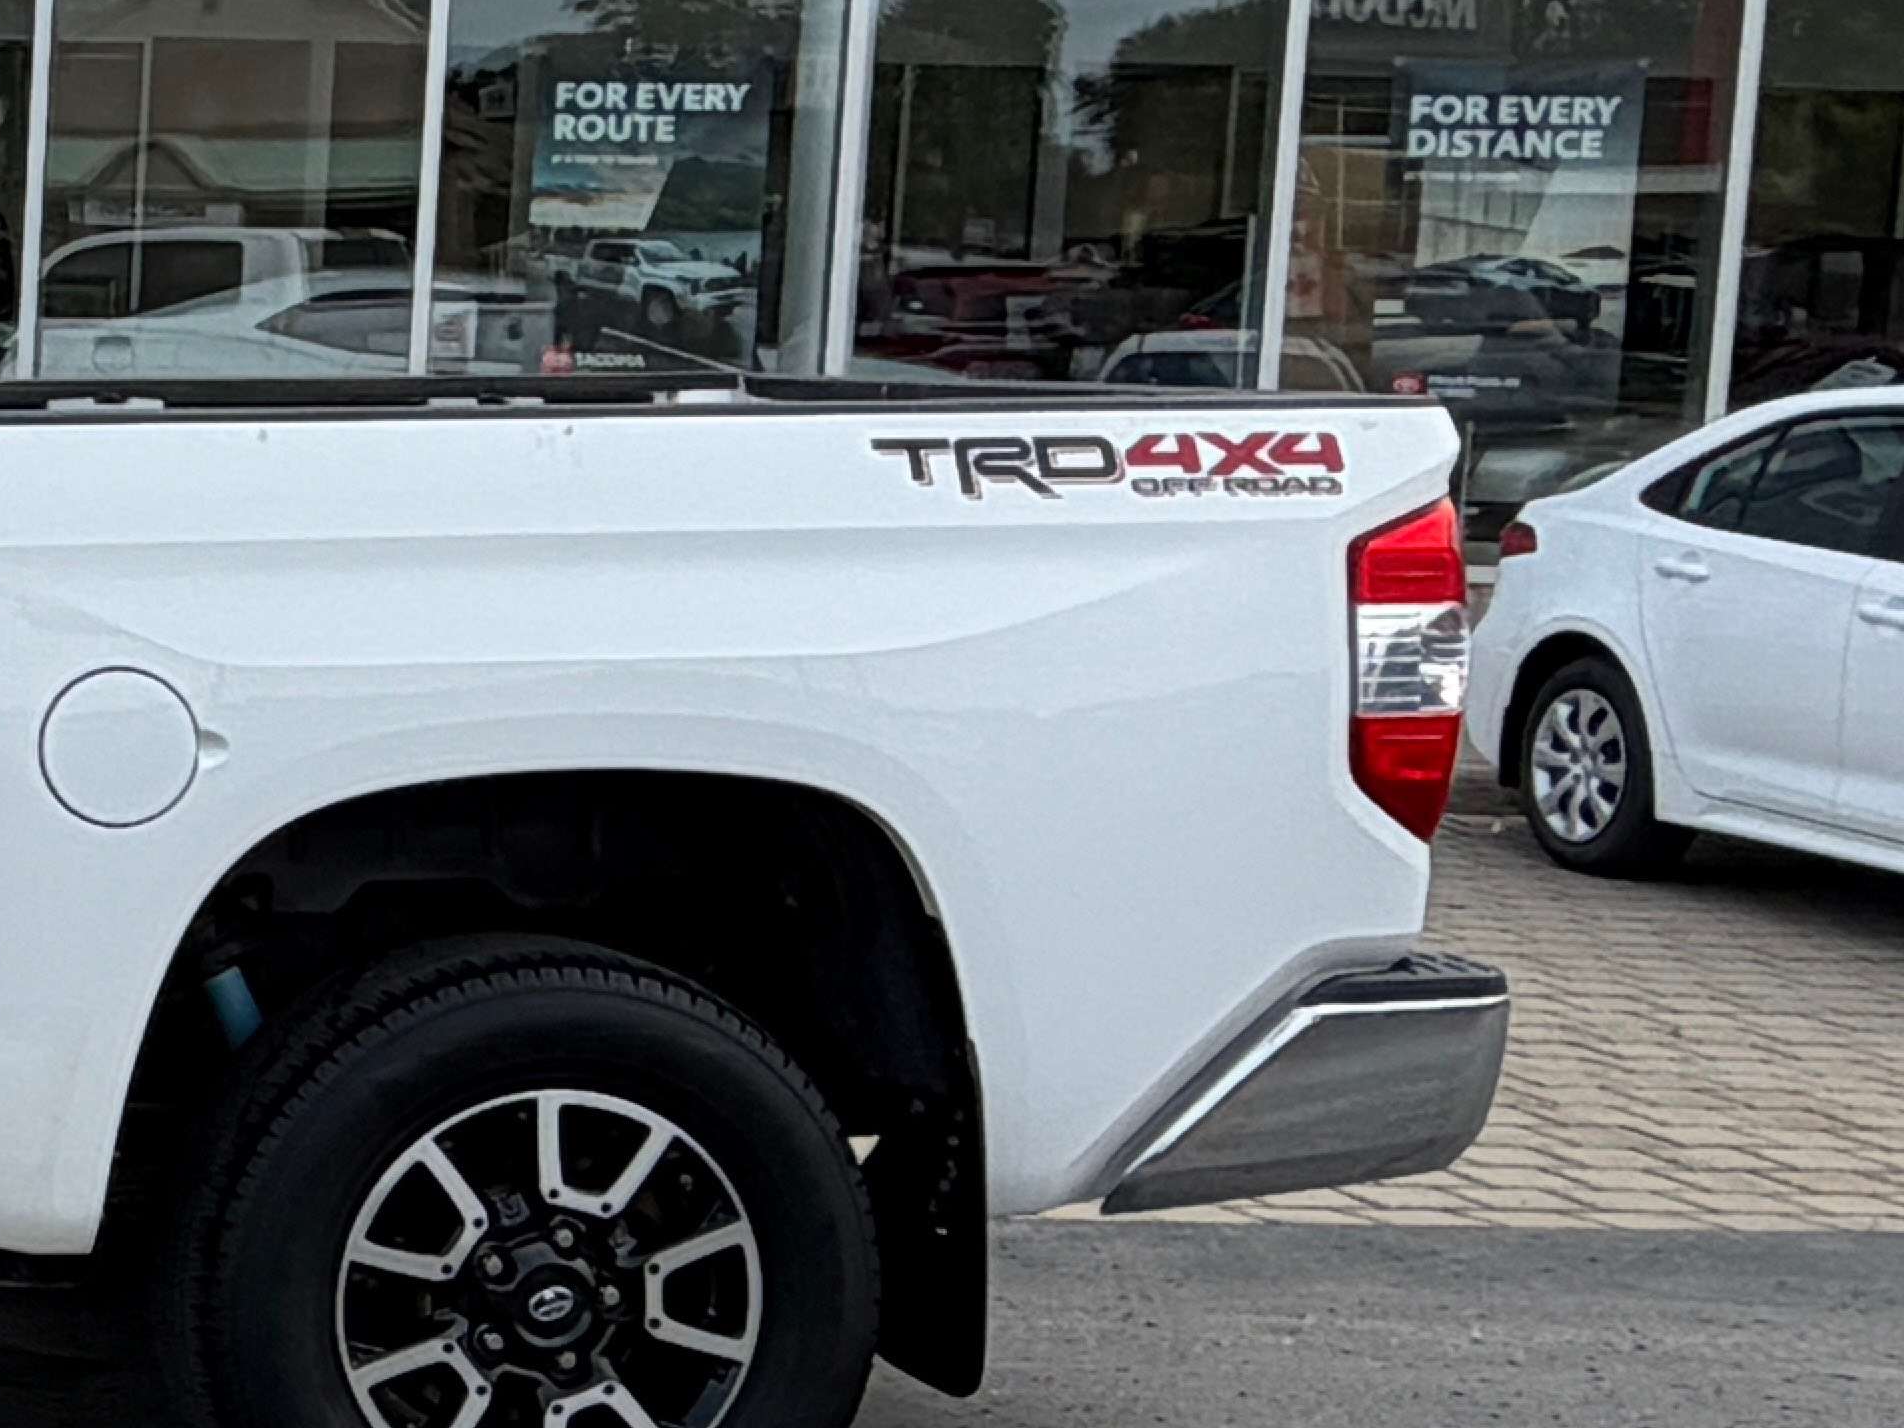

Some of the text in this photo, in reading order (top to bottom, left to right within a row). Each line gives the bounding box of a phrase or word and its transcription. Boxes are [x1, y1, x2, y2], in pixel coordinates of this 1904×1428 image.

[554, 80, 752, 112] FOR EVERY
[1409, 94, 1624, 126] FOR EVERY
[553, 112, 677, 143] ROUTE
[1405, 128, 1605, 159] DISTANCE
[870, 435, 1126, 501] TRD
[1131, 476, 1344, 498] OFF ROAD
